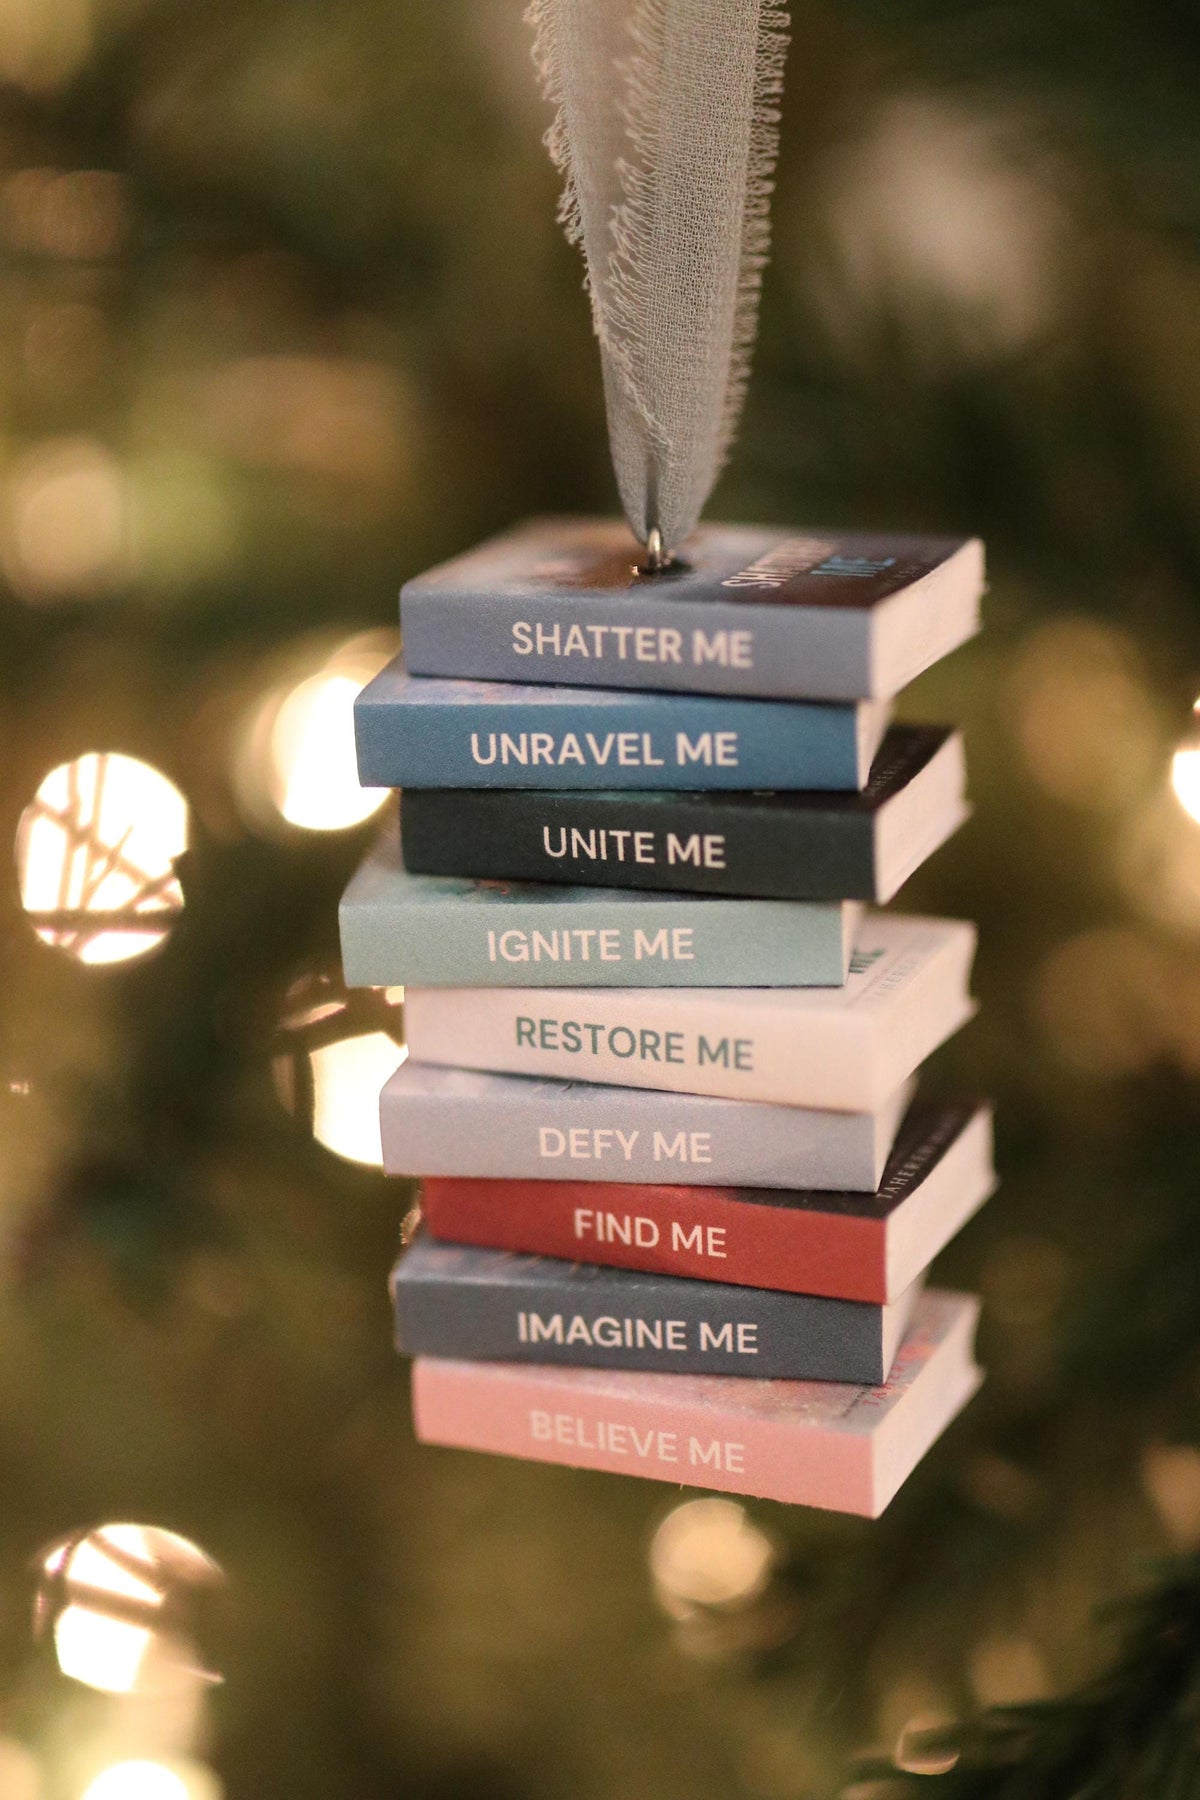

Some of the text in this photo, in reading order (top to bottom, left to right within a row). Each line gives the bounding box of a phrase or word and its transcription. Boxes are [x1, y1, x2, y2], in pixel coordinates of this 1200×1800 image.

[512, 621, 755, 669] SHATTER ME
[470, 731, 740, 767] UNRAVEL ME
[543, 825, 727, 869] UNITE ME
[487, 927, 695, 962] IGNITE ME
[514, 1015, 755, 1071] RESTORE ME
[538, 1126, 713, 1164] DEFY ME
[573, 1207, 728, 1258] FIND ME
[517, 1311, 759, 1354] IMAGINE ME
[529, 1408, 746, 1474] BELIEVE ME
